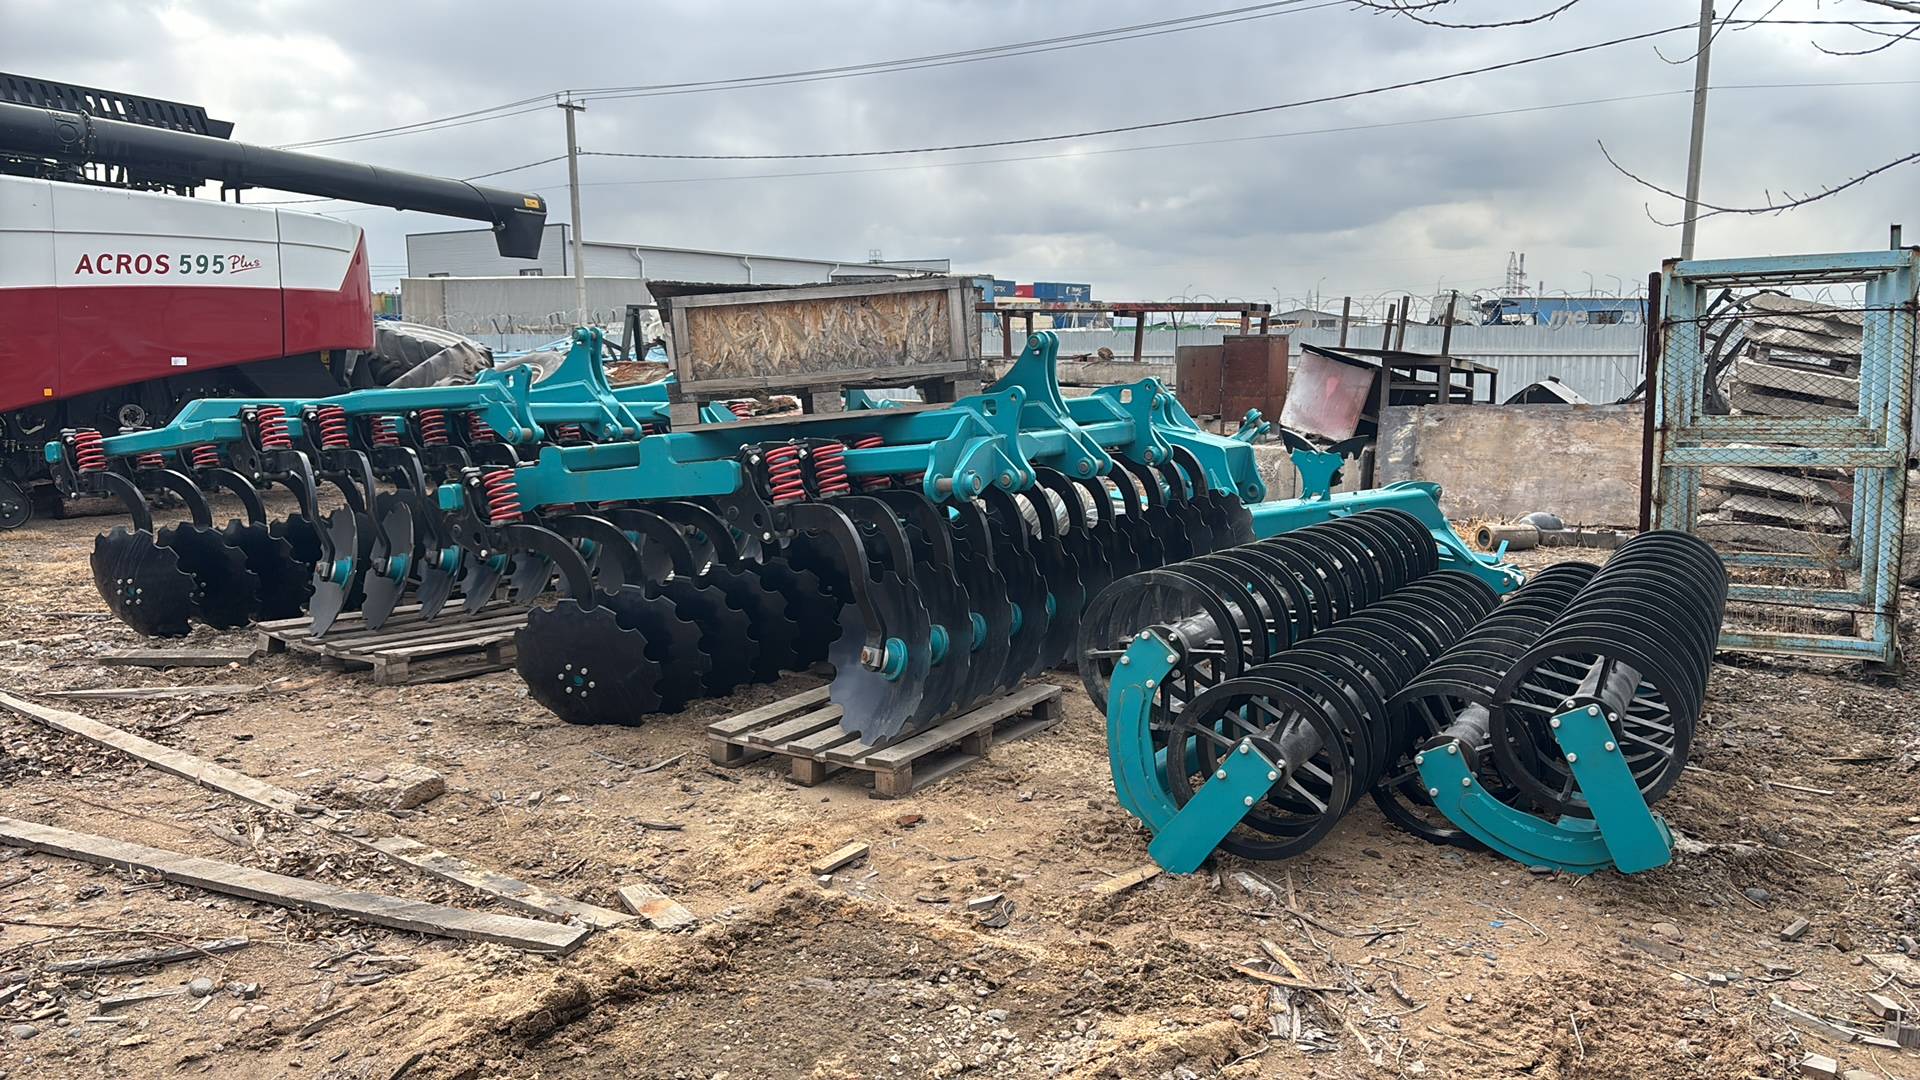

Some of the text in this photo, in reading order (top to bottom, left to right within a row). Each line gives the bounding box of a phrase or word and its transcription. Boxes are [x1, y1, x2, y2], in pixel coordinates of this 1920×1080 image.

[74, 253, 262, 275] ACROS 595 Plus
